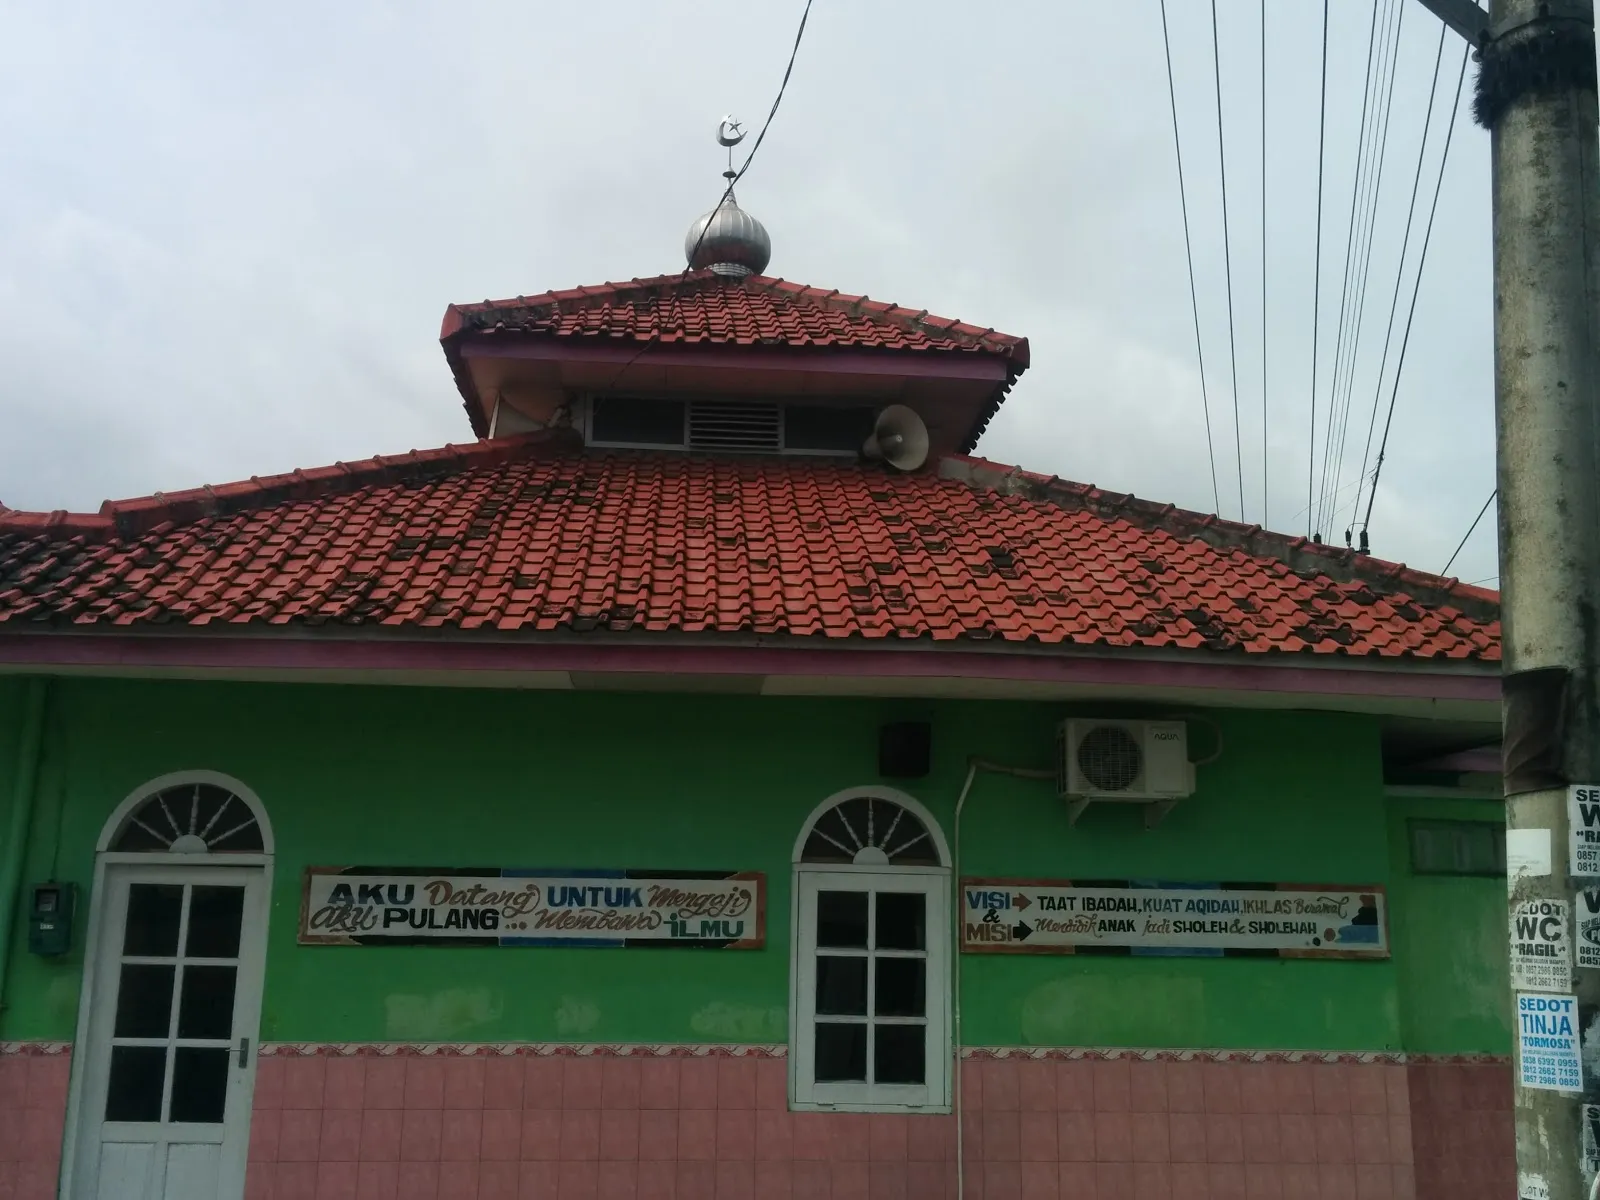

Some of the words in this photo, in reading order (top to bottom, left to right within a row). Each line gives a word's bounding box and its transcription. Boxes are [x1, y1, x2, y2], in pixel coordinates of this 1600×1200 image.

[1154, 733, 1179, 741] AQUA
[1577, 850, 1597, 861] 0857
[1577, 862, 1598, 872] 0812
[327, 883, 415, 905] AKU
[423, 880, 540, 918] Datang
[547, 886, 643, 907] UNTUK
[646, 884, 752, 919] Mengaji
[966, 890, 1010, 910] VISI
[1037, 895, 1077, 911] TAAT
[534, 908, 662, 931] Membawa
[982, 908, 1001, 923] &
[966, 923, 1012, 942] MISI
[1098, 919, 1136, 932] ANAK
[1142, 915, 1171, 936] jadi
[1173, 920, 1228, 934] SHOLEH
[1229, 919, 1246, 934] &
[1249, 920, 1317, 935] SHOLEHAH
[1516, 917, 1562, 942] WC
[1520, 998, 1573, 1012] SEDOT
[1521, 1014, 1573, 1036] TINJA
[1538, 1057, 1555, 1065] 6392
[1557, 1059, 1578, 1067] 0955
[1558, 1068, 1578, 1077] 7159
[1559, 1078, 1580, 1087] 0850
